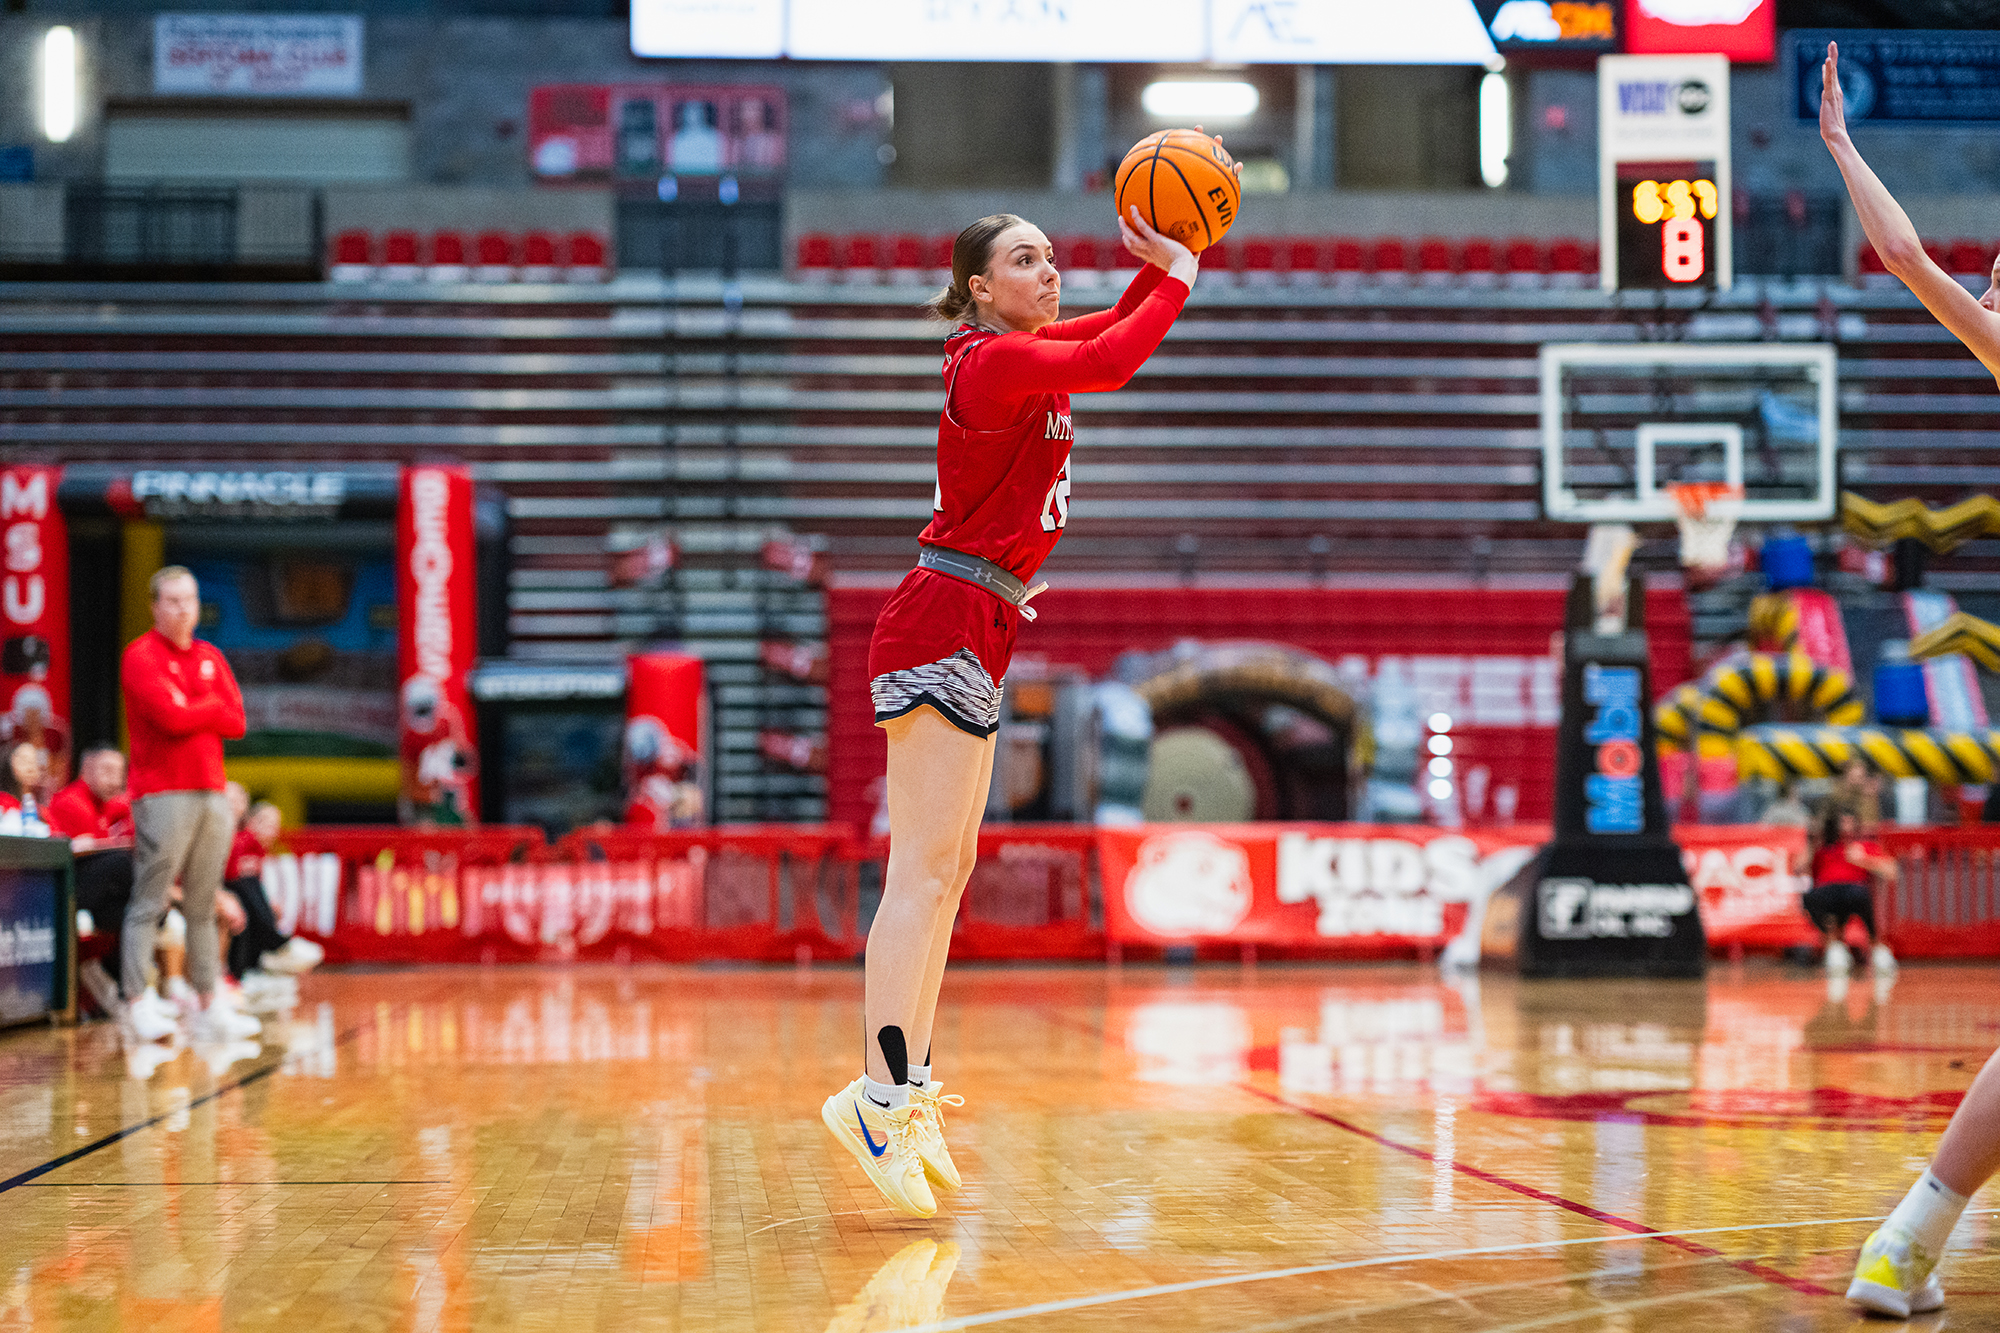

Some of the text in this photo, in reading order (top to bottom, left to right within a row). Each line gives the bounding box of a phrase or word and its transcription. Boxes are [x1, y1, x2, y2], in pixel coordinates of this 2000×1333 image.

[132, 470, 345, 505] PINNACLE
[0, 470, 46, 624] MSU
[1277, 831, 1479, 903] KIDS
